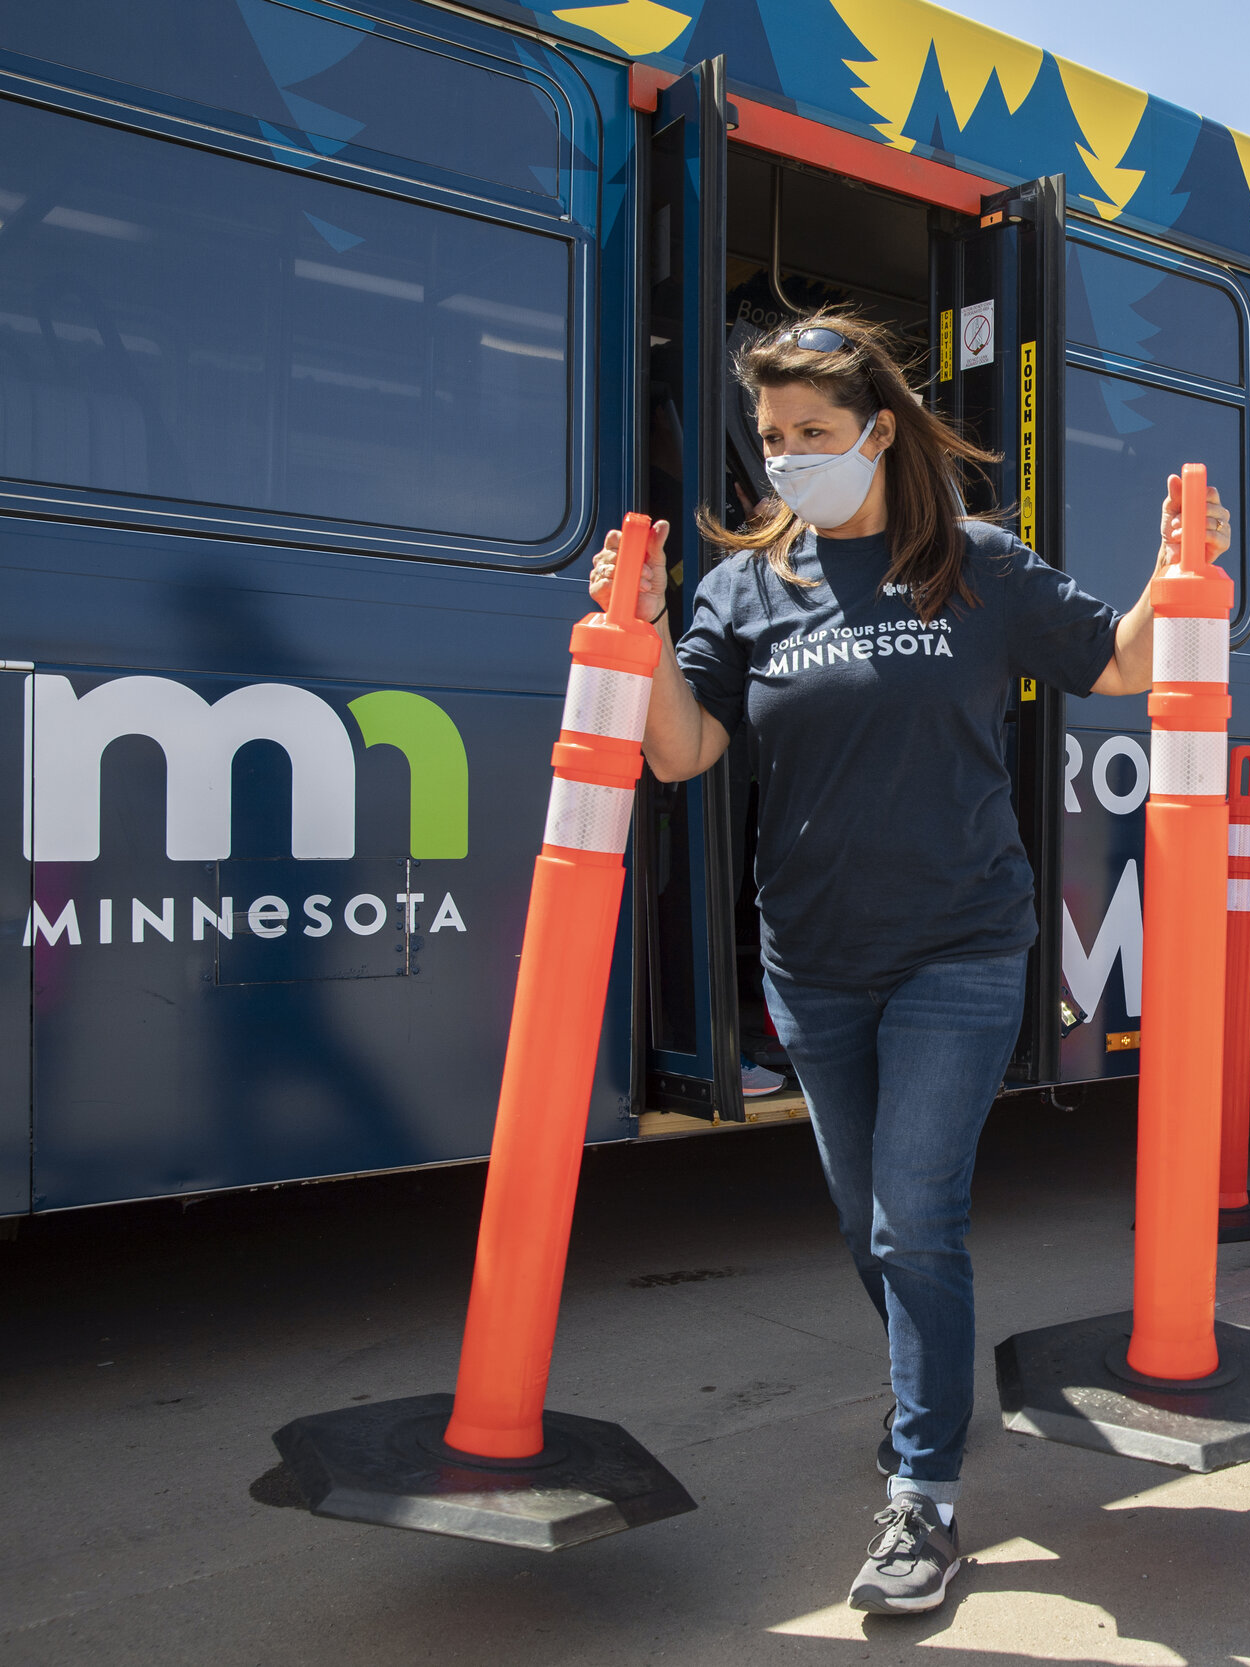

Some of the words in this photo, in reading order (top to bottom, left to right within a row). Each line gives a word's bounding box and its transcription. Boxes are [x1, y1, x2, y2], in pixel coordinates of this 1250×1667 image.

[1024, 349, 1032, 423] TOUCH
[1024, 432, 1032, 490] HERE
[770, 634, 804, 654] ROLL
[807, 630, 828, 643] UP
[831, 624, 874, 639] YOUR
